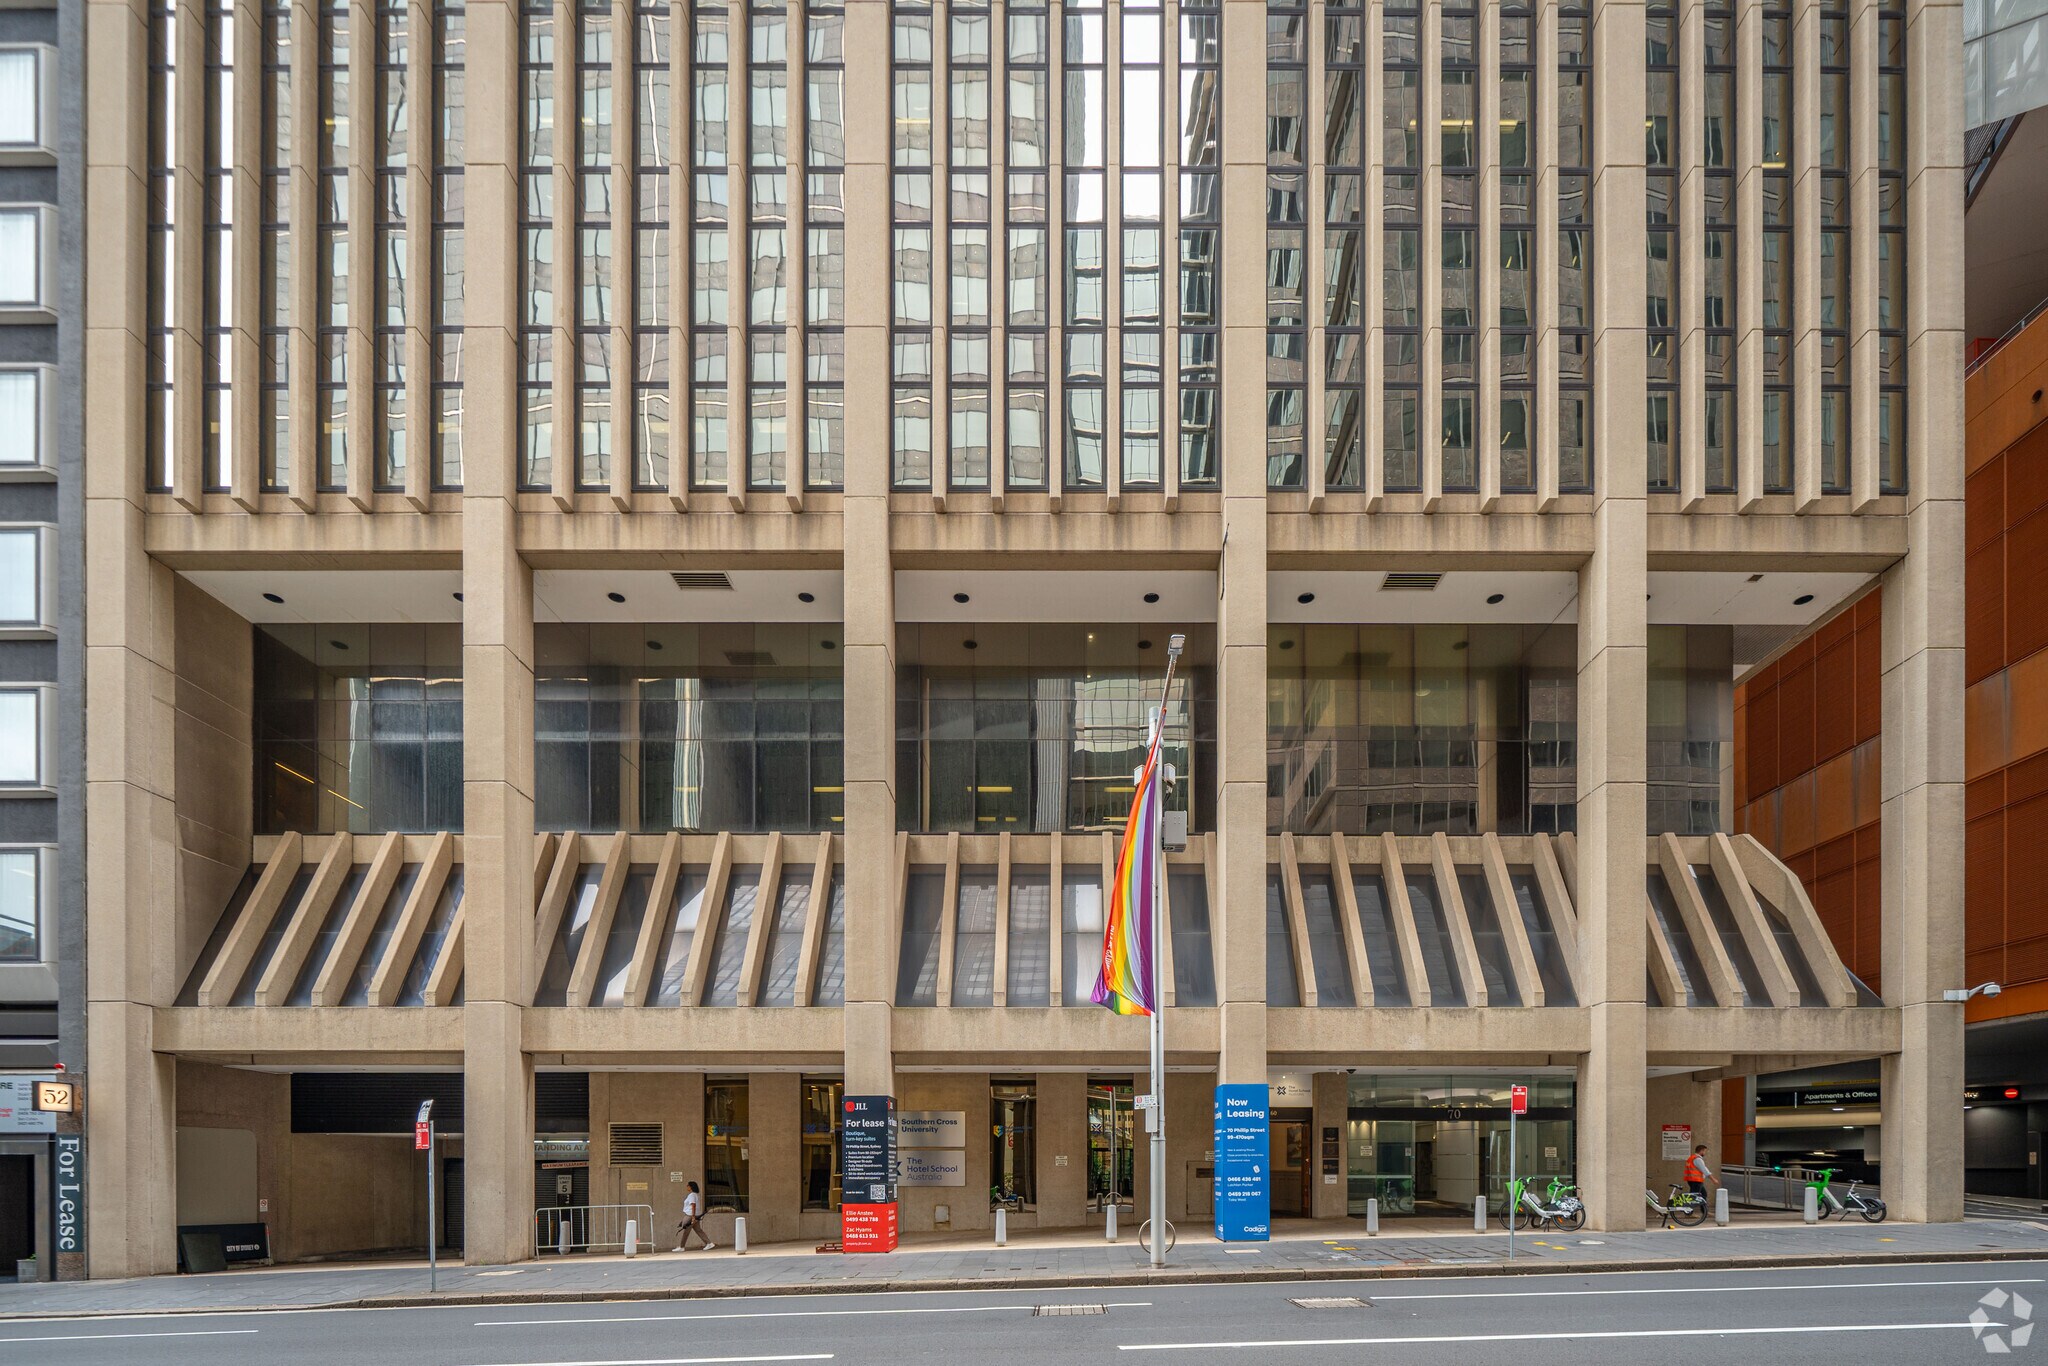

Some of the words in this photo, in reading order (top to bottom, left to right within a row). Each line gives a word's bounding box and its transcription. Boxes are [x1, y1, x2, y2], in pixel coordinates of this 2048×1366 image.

[44, 1089, 69, 1105] 52
[1804, 1092, 1844, 1100] Apartments
[855, 1102, 868, 1110] JLL
[1227, 1098, 1248, 1106] Now
[1227, 1108, 1265, 1119] Leasing
[1447, 1109, 1461, 1119] 70
[846, 1119, 860, 1128] For
[862, 1118, 885, 1128] lease
[59, 1138, 80, 1178] For
[59, 1183, 80, 1250] Lease
